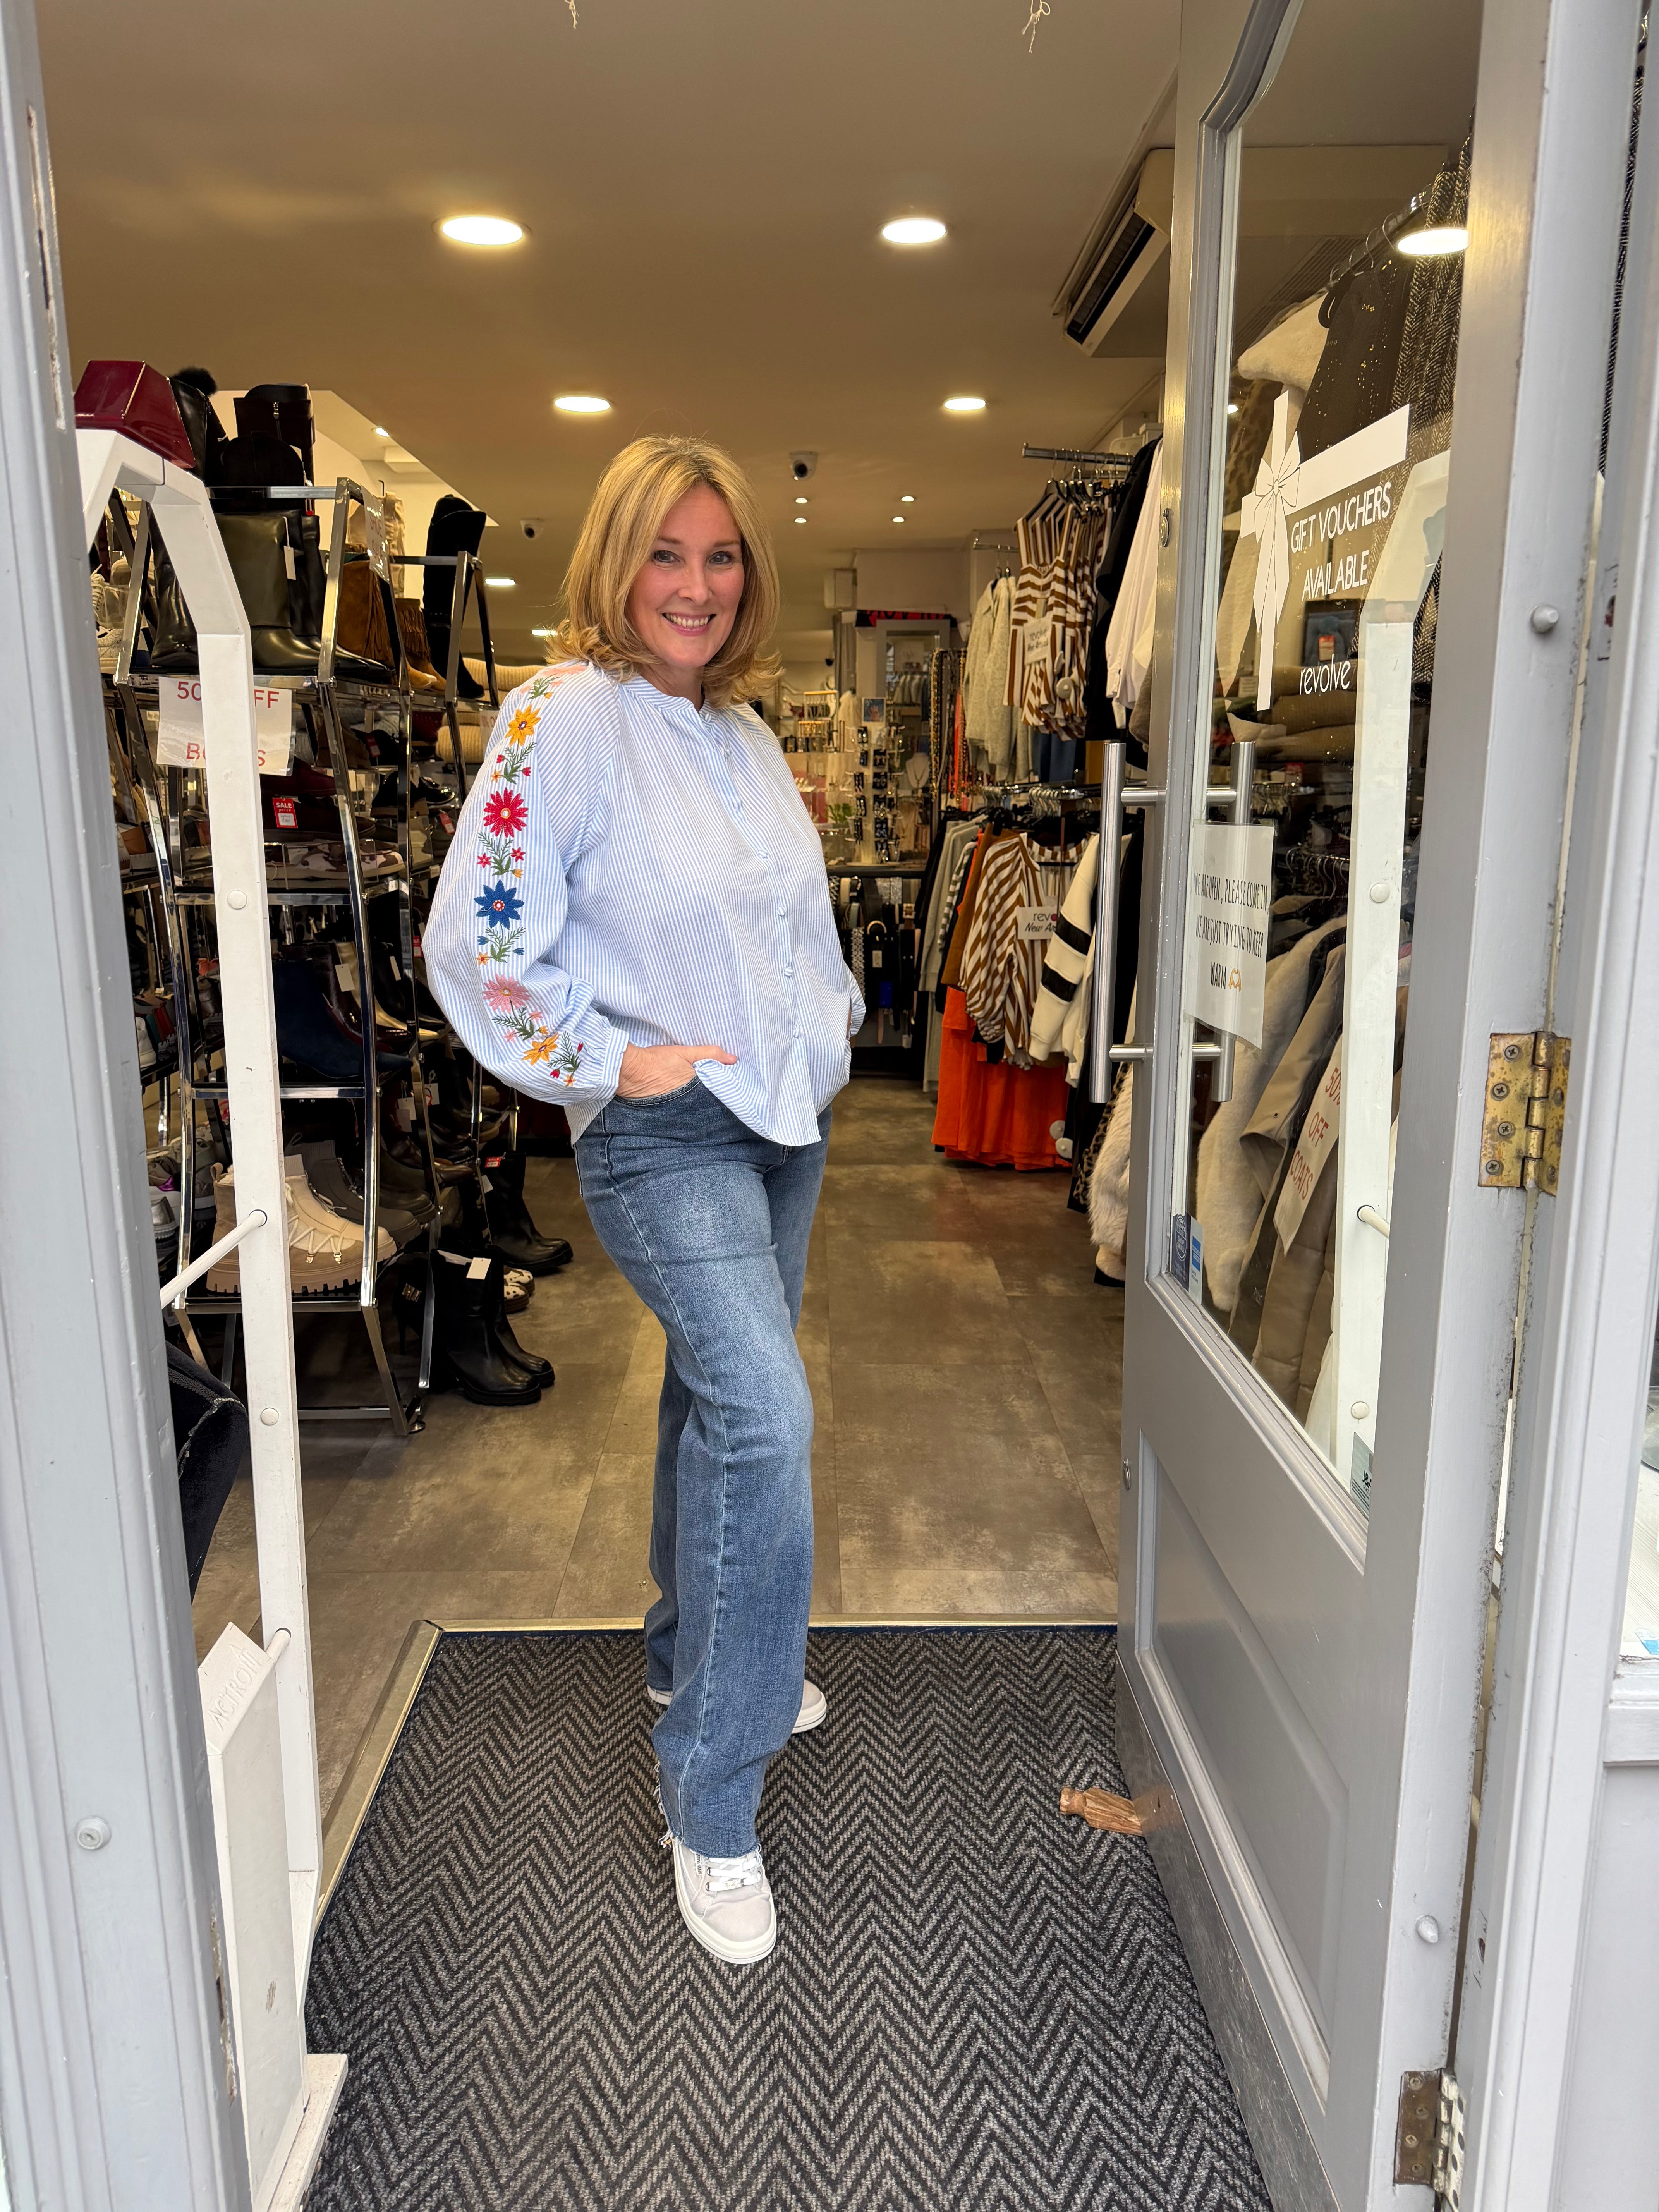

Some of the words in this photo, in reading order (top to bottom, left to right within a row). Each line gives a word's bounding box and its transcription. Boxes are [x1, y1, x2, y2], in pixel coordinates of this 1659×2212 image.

[1291, 514, 1316, 553] GIFT
[1319, 481, 1391, 542] VOUCHERS
[1301, 550, 1369, 602] AVAILABLE
[177, 681, 202, 701] 50
[254, 689, 279, 708] FF
[1299, 654, 1351, 695] revolve
[1194, 873, 1200, 896] WE
[1225, 878, 1246, 906] PLEASE
[1247, 881, 1260, 909] COME
[1196, 914, 1202, 938] WE
[1202, 916, 1210, 941] ARE
[1209, 919, 1221, 945] JUST
[1223, 922, 1245, 951] TRYING
[1247, 927, 1252, 954] TO
[1252, 929, 1264, 958] KEEP
[1211, 962, 1227, 989] WARM
[1308, 1111, 1329, 1147] OFF
[1290, 1150, 1314, 1200] COATS
